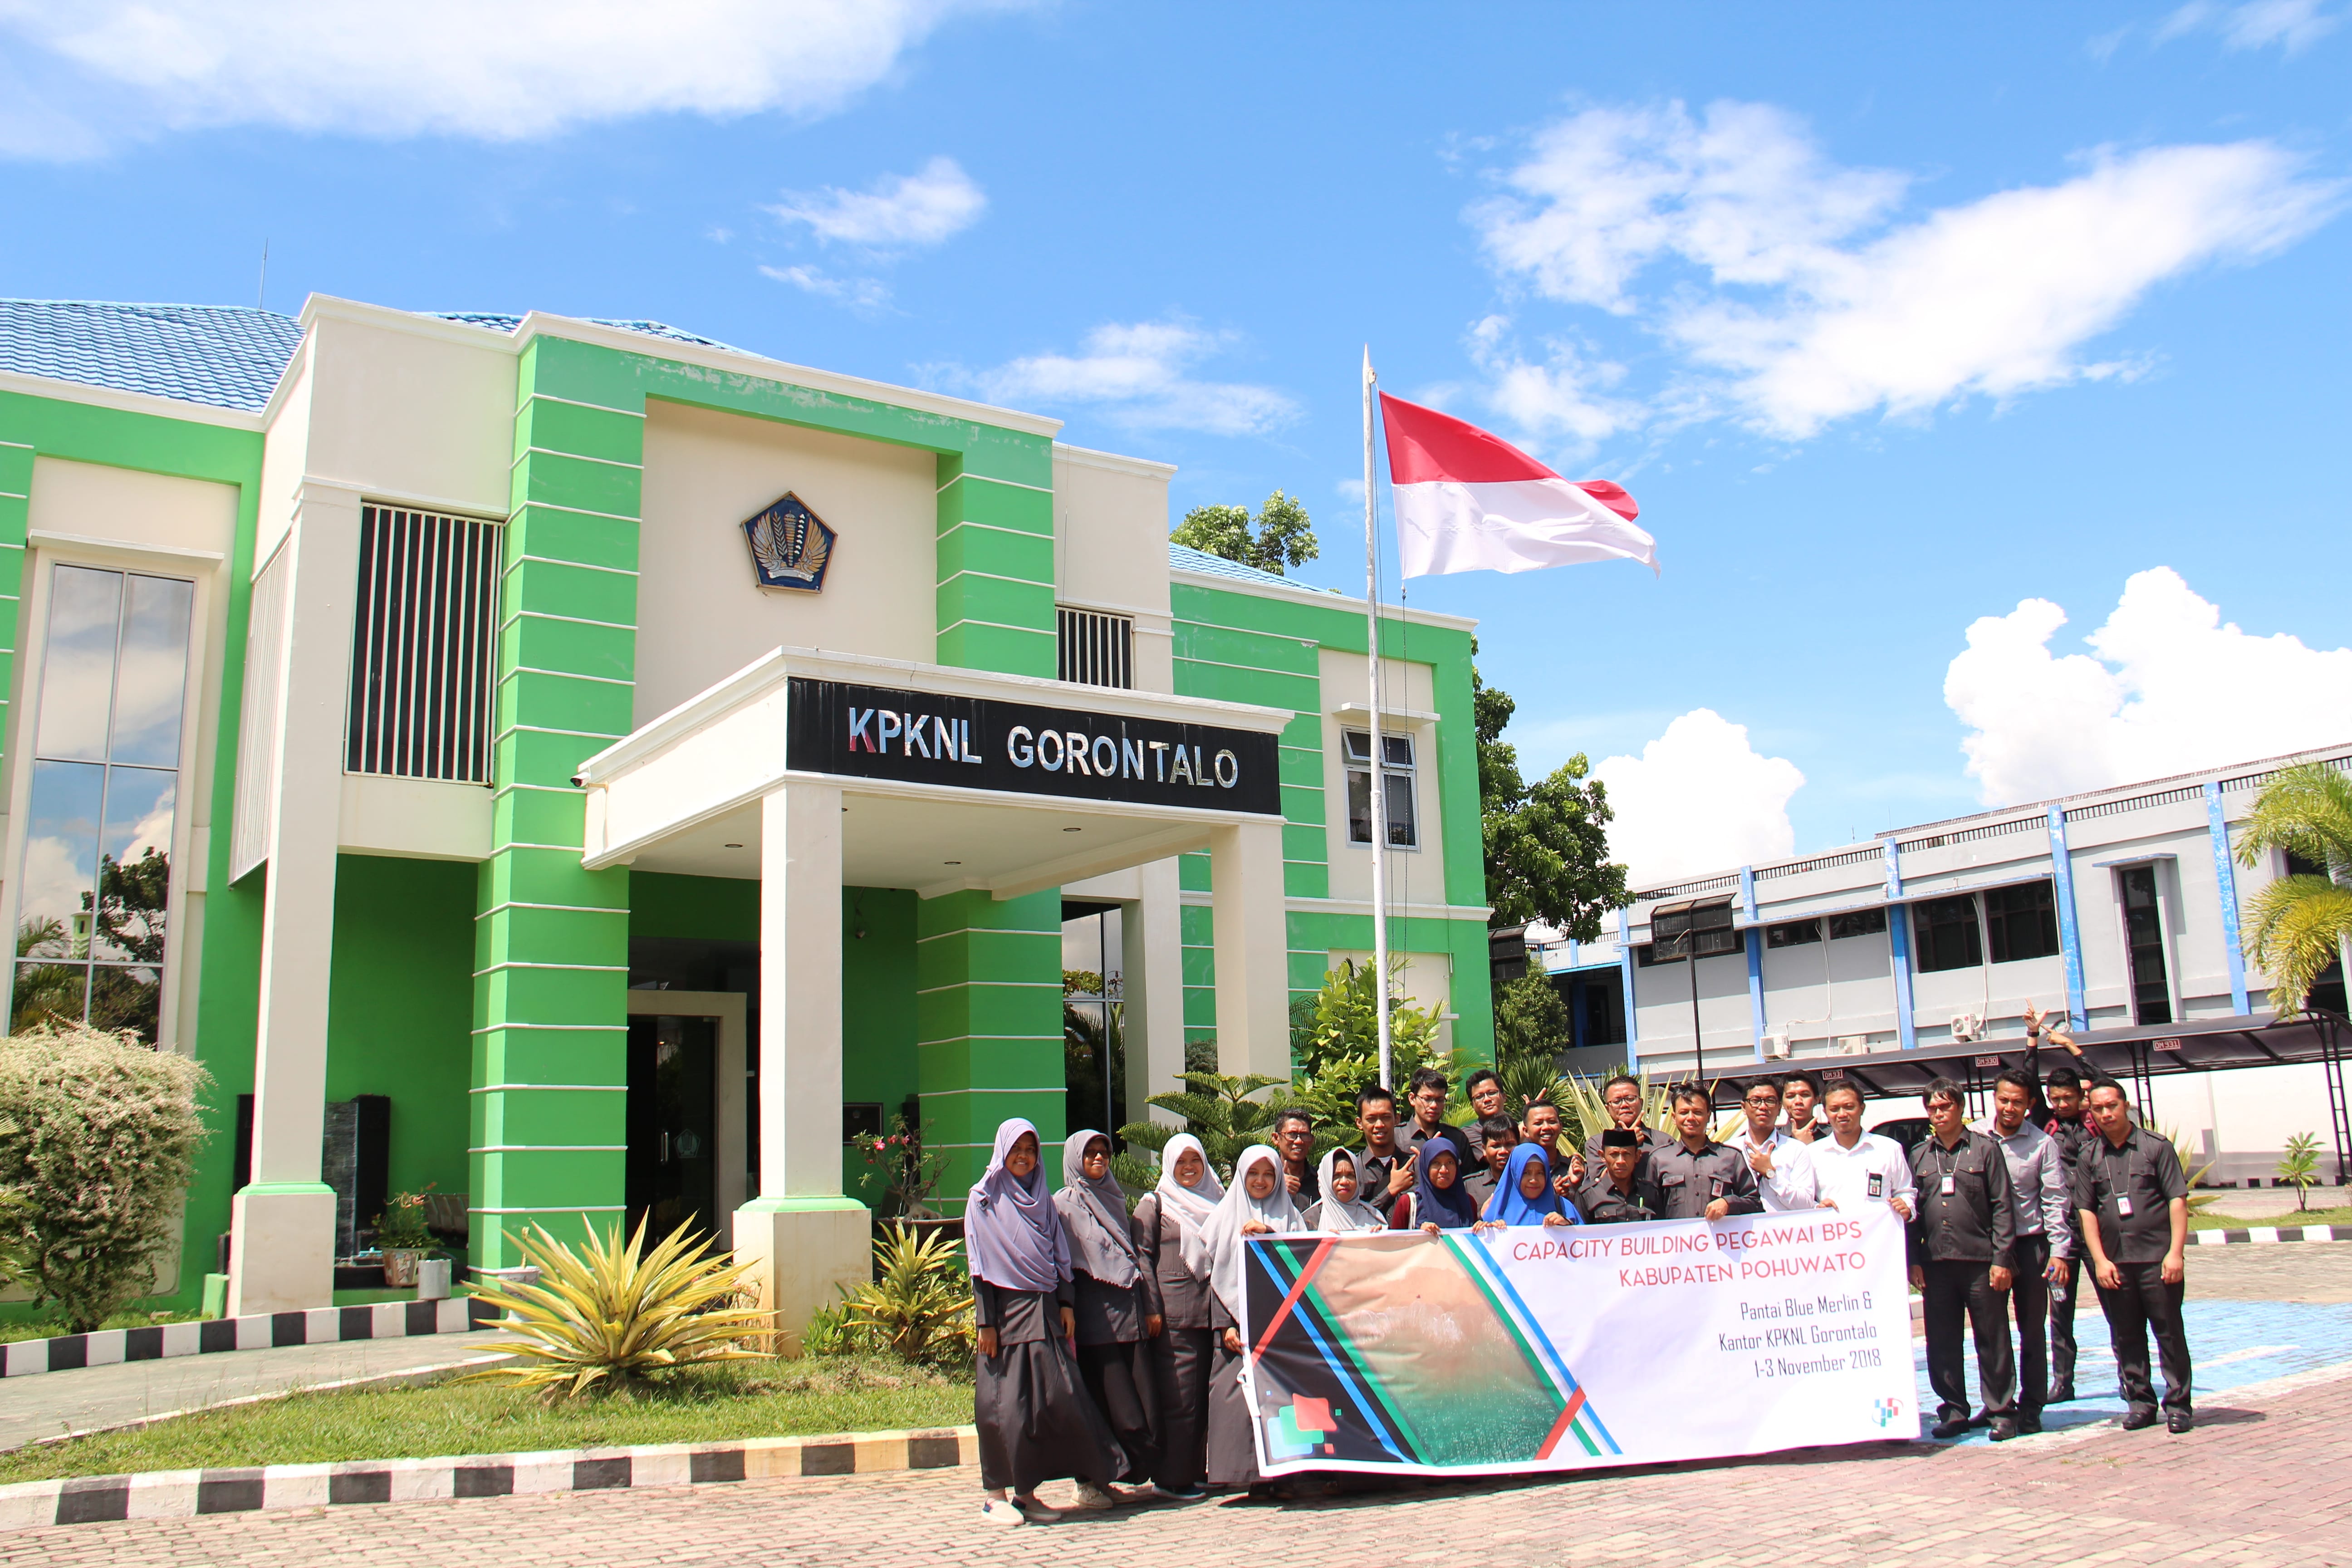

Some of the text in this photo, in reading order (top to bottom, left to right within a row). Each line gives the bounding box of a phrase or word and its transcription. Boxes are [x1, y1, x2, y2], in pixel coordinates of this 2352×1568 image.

[849, 707, 1238, 789] KPKNL GORONTALO
[1513, 1221, 1862, 1261] CAPACITY BUILDING PEGAWAI BPS
[1619, 1252, 1866, 1287] KABUPATEN POHUWATO
[1740, 1291, 1872, 1320] Pantai Blue Merlin &
[1719, 1320, 1877, 1351] Kantor KPKNL Gorontalo
[1754, 1348, 1882, 1377] 1-3 November 2018
